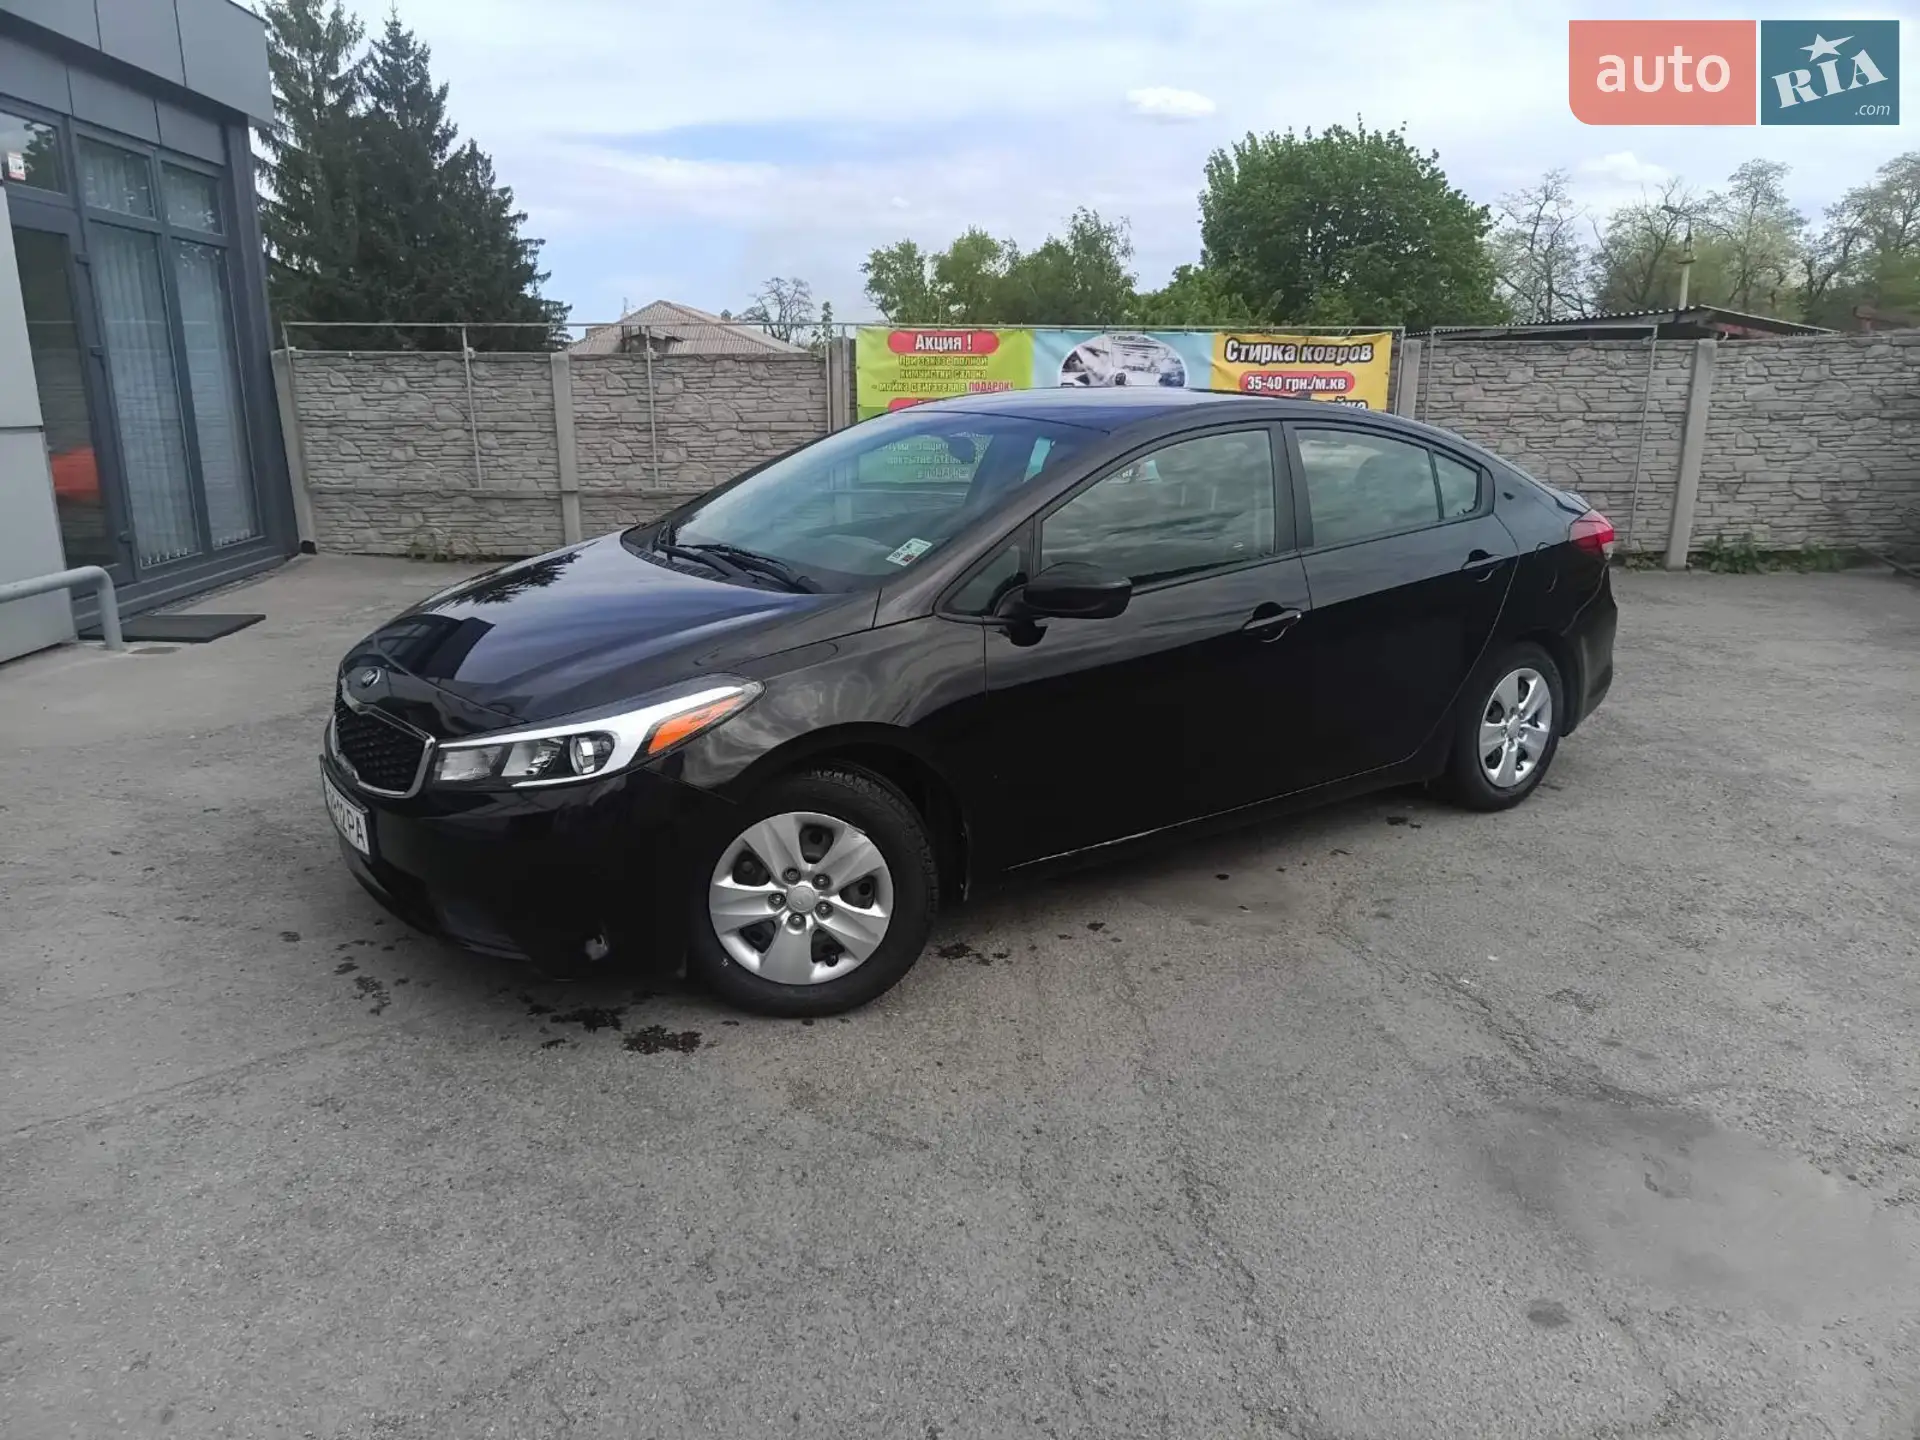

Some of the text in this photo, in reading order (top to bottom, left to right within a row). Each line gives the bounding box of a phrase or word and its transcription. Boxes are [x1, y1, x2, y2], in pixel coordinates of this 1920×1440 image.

[915, 333, 962, 353] Акция
[1225, 338, 1374, 364] Стирка ковров
[1247, 375, 1347, 394] 35-40 грн./м.кв
